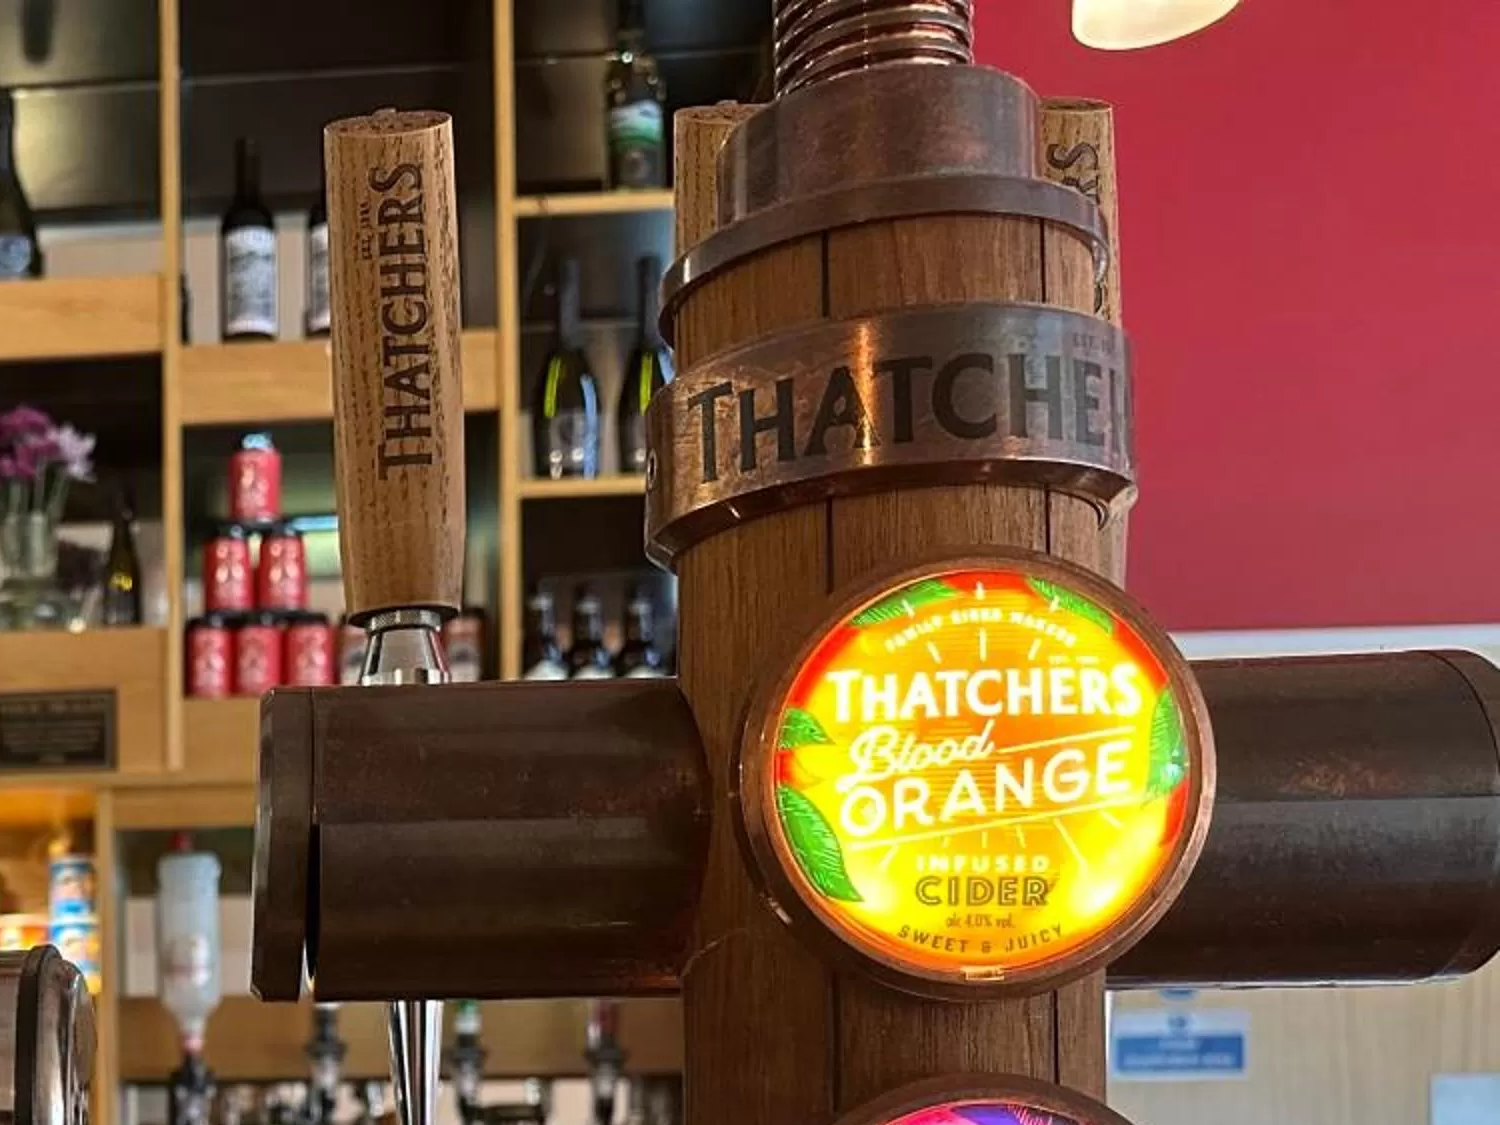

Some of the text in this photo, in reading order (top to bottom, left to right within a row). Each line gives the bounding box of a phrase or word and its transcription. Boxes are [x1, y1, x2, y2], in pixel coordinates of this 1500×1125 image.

[368, 163, 433, 481] THATCHERS
[825, 663, 1143, 723] THATCHERS
[836, 720, 996, 793] Blood
[840, 739, 1133, 838] ORANGE
[915, 855, 1050, 873] INFUSED
[915, 875, 1049, 906] CIDER
[898, 924, 970, 953] SWEET
[1005, 922, 1063, 953] JUICY
